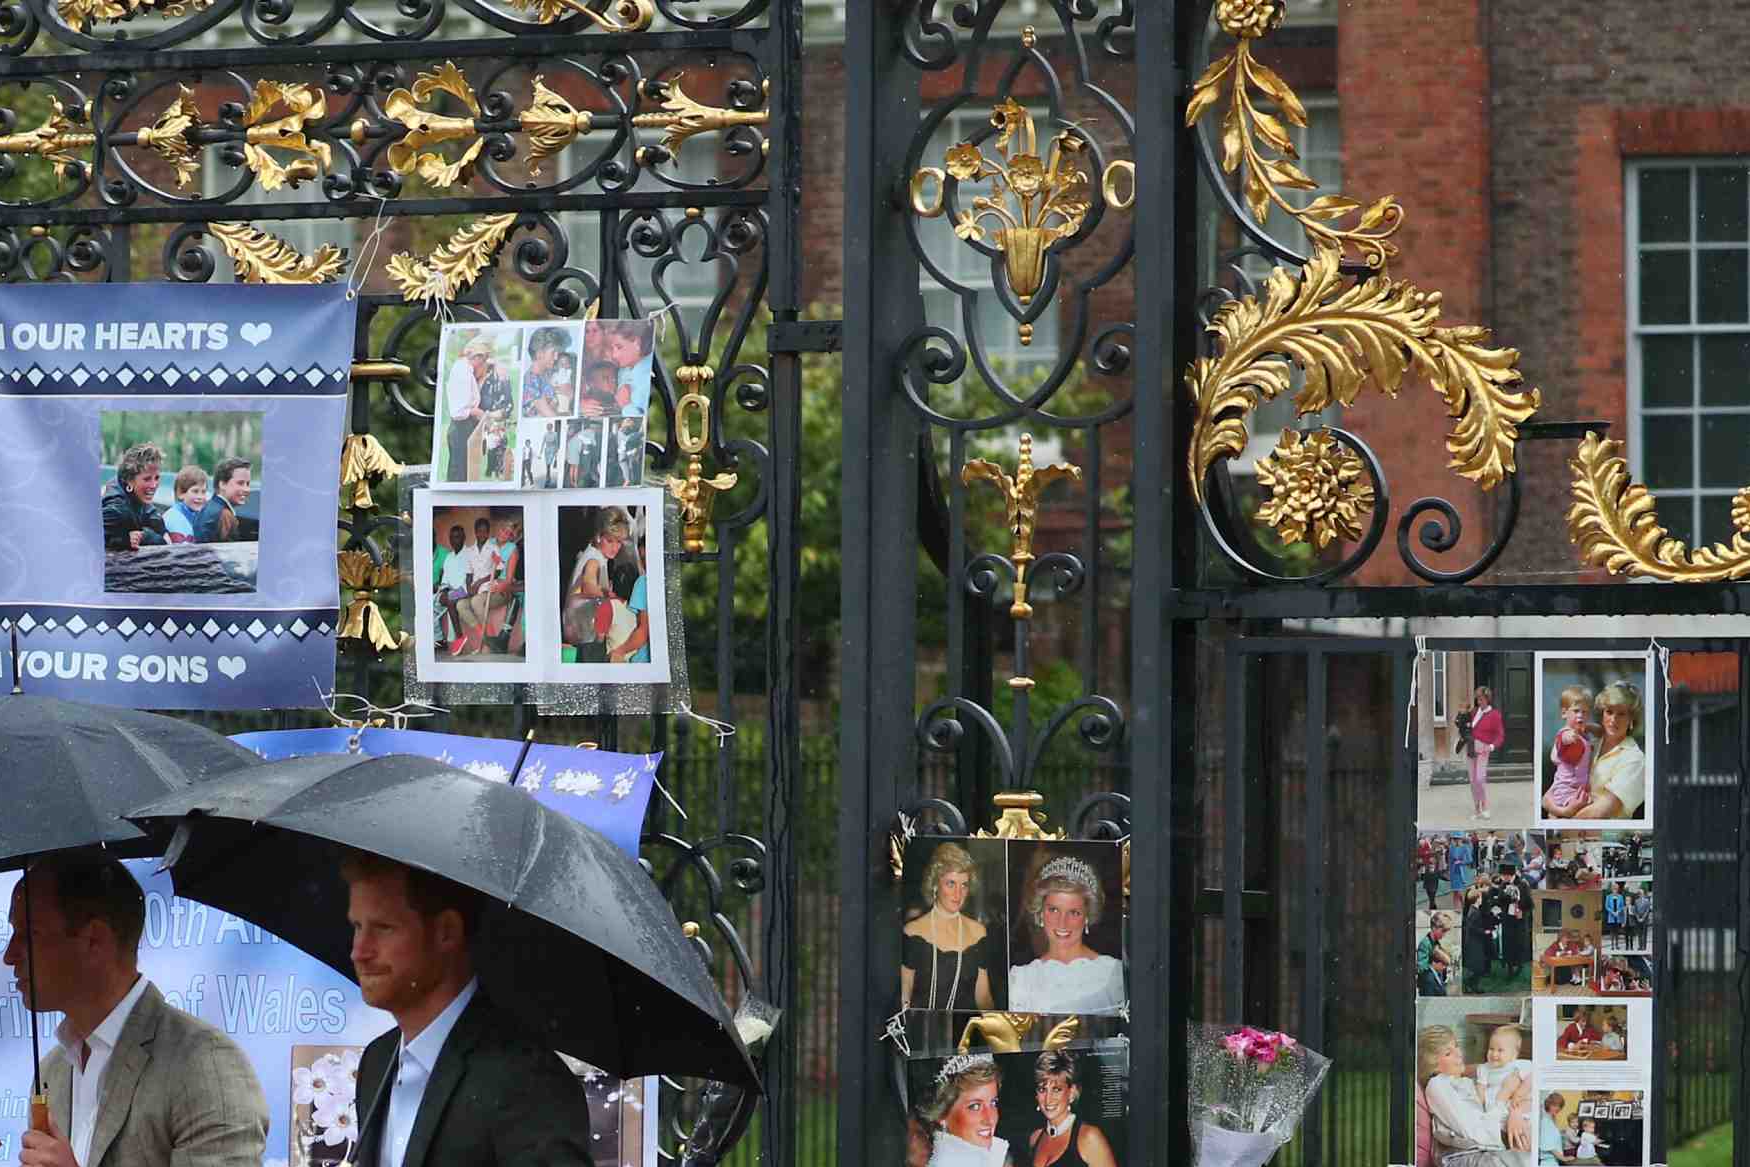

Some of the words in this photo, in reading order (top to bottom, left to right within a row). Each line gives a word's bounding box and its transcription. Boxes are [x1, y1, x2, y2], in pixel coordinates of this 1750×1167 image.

[11, 322, 86, 351] OUR
[94, 321, 229, 351] HEARTS
[13, 651, 108, 682] YOUR
[117, 654, 209, 684] SONS
[139, 891, 207, 949] 0th
[217, 973, 347, 1034] Wales
